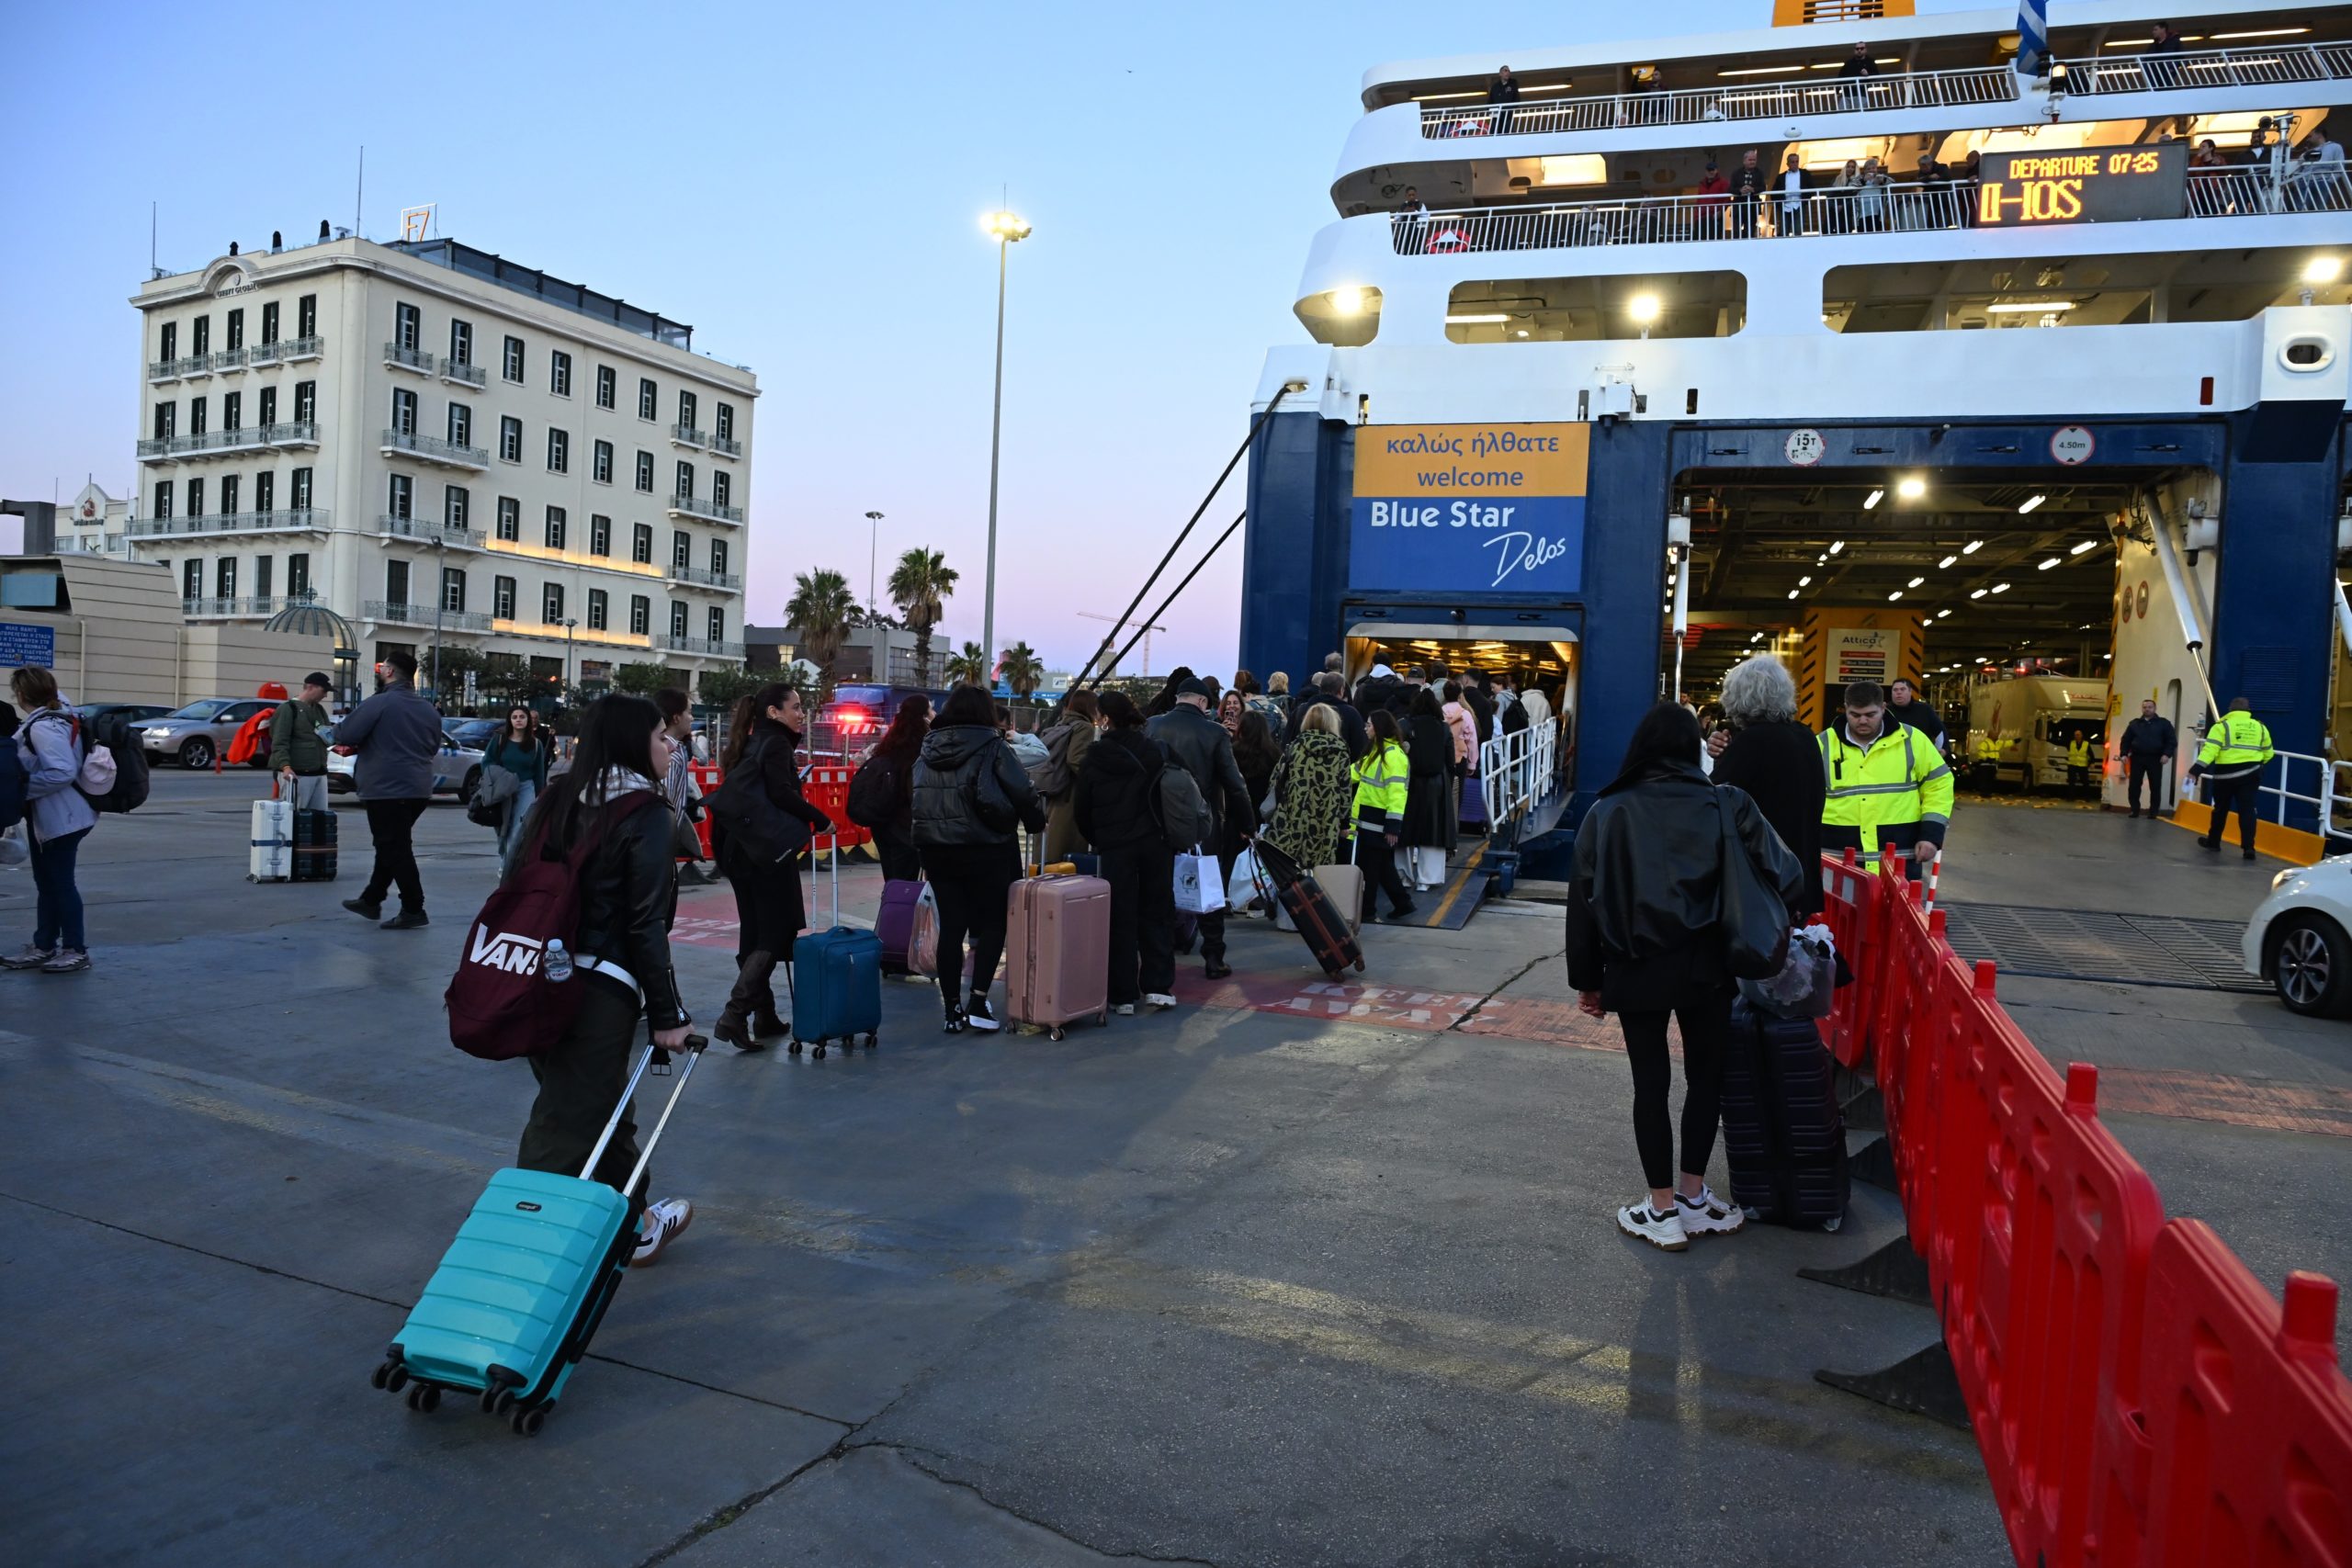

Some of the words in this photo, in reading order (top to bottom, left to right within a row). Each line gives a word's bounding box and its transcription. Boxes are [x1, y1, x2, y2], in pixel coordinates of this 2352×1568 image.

[2009, 155, 2100, 179] DEPARTURE
[2109, 152, 2158, 175] 07:25
[1386, 433, 1464, 457] καλώς
[1472, 431, 1559, 457] ήλθατε
[2059, 441, 2086, 449] 4.50m
[1417, 466, 1524, 487] welcome
[1371, 501, 1441, 527] Blue
[1450, 501, 1515, 527] Star
[1482, 531, 1566, 587] Delos
